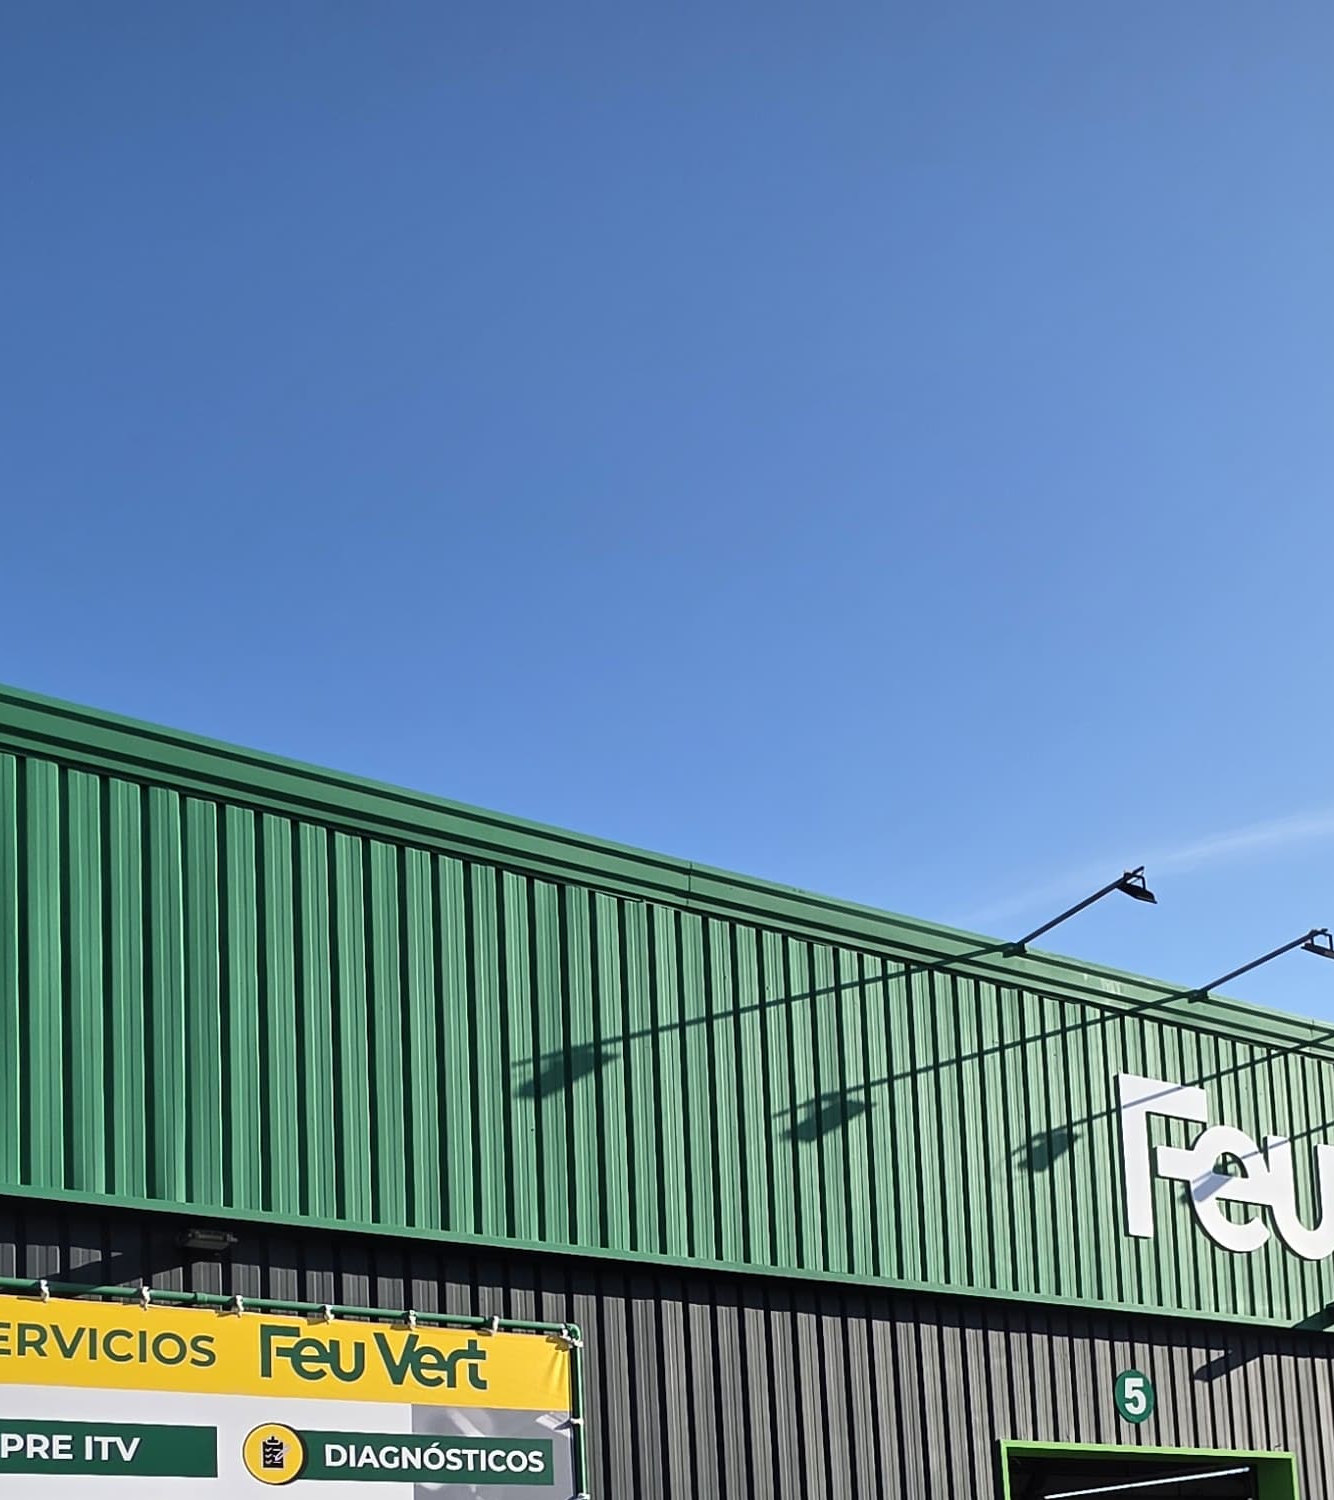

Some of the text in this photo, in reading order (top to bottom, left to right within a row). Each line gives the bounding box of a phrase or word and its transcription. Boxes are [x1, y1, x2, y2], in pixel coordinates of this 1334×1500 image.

[260, 1324, 365, 1381] Feu
[373, 1332, 487, 1389] Vert
[1124, 1377, 1147, 1414] 5
[0, 1433, 141, 1462] PRE ITV
[324, 1441, 545, 1473] DIAGNÓSTICOS
